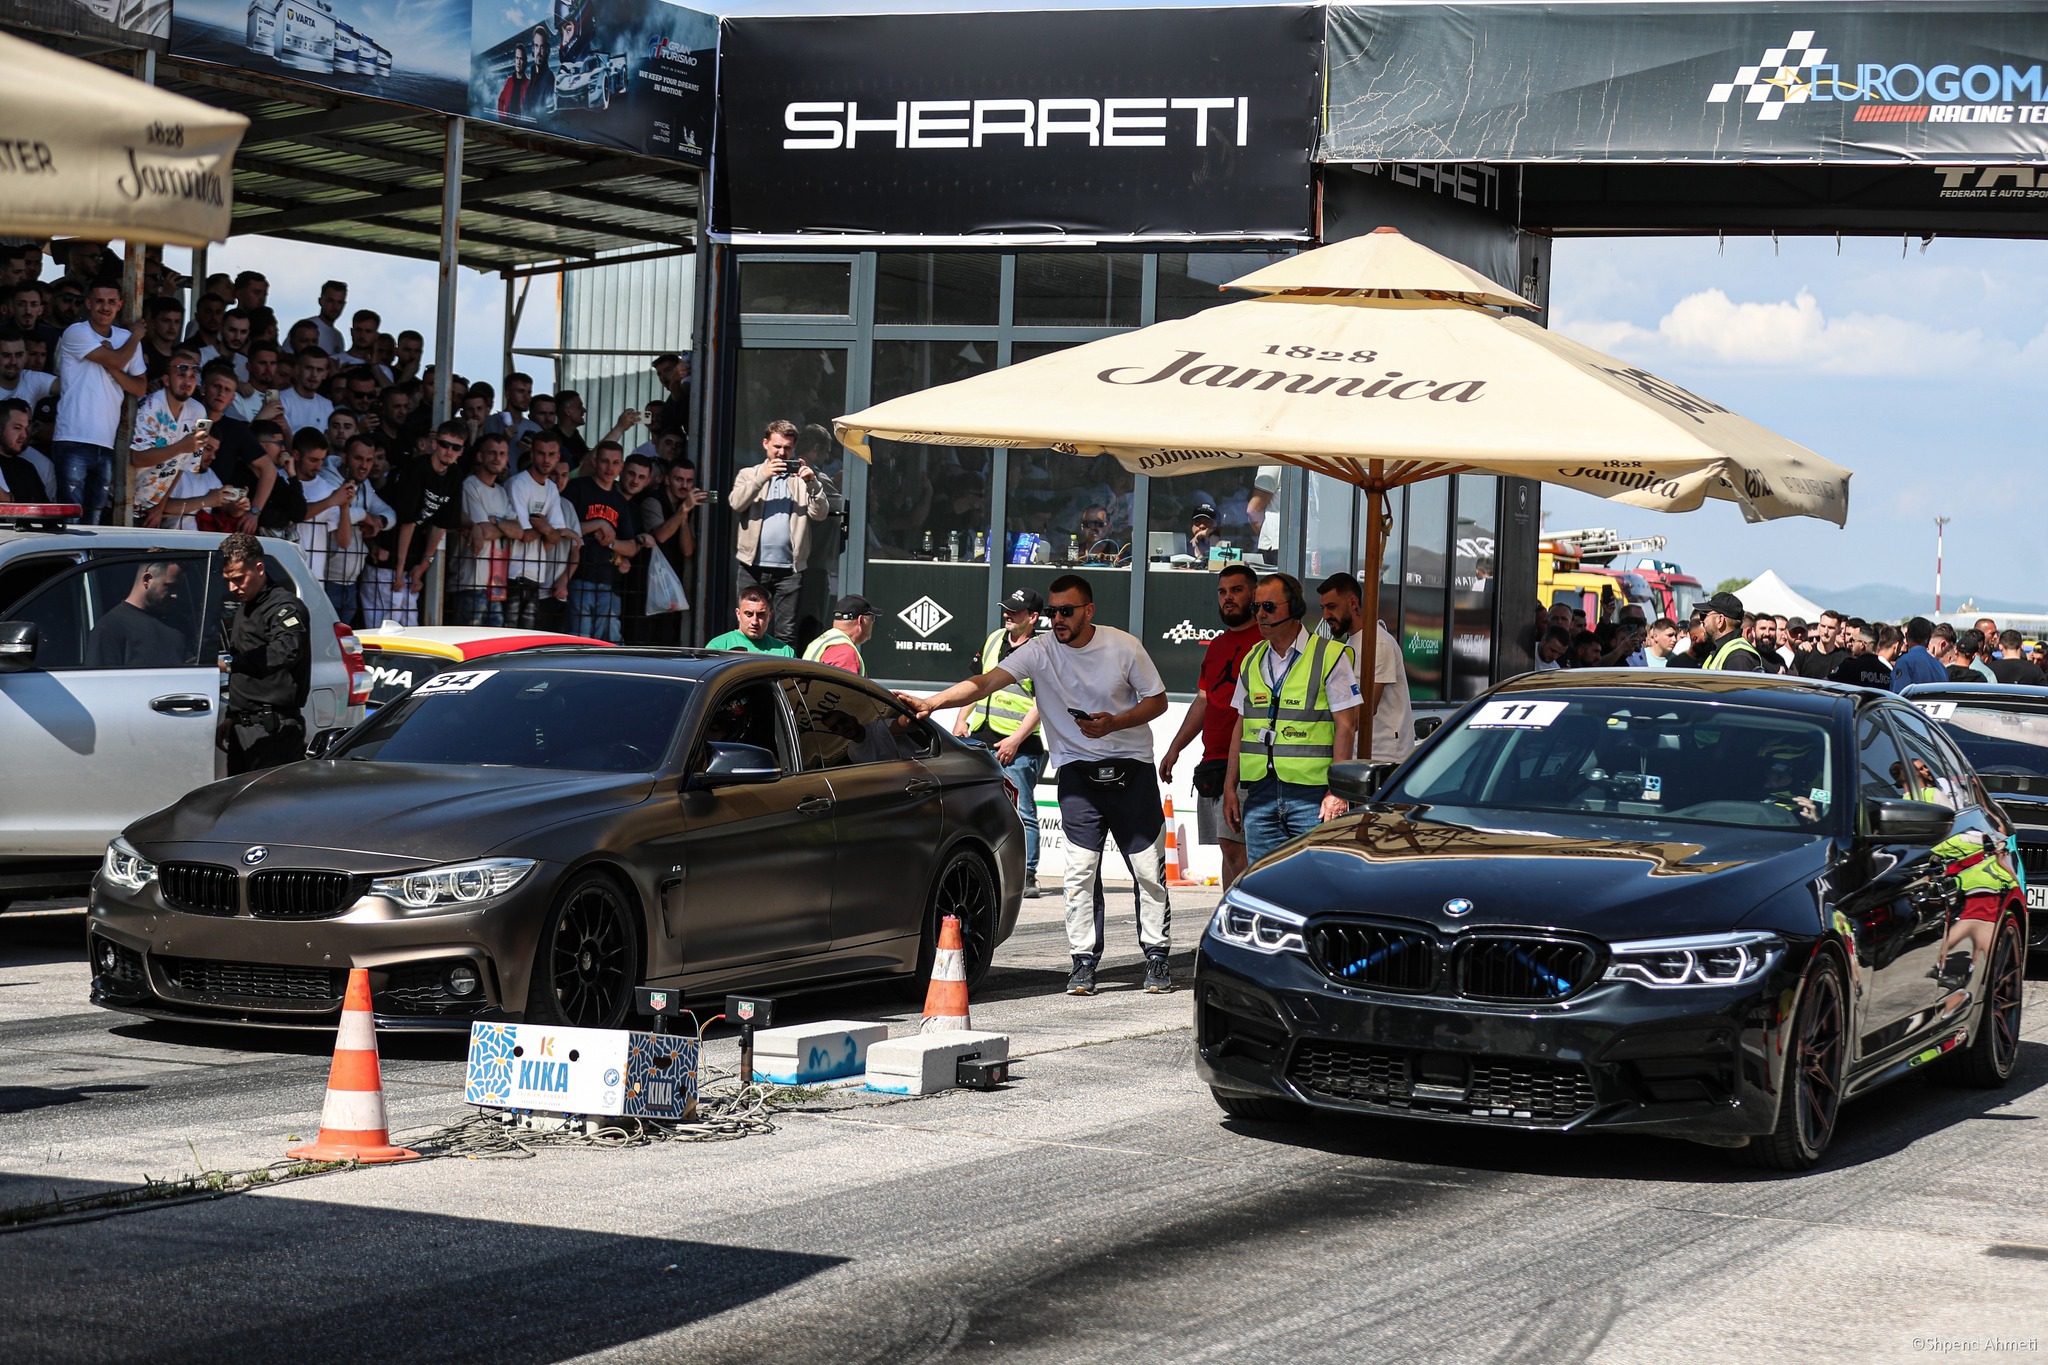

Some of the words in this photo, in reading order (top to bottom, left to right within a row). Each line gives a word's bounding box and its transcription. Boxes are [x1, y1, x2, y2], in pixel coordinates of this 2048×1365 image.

[295, 11, 316, 29] VARTA
[668, 41, 691, 55] GRAN
[661, 49, 698, 67] TURISMO
[638, 69, 648, 79] WE
[648, 72, 663, 82] KEEP
[662, 76, 678, 87] YOUR
[677, 79, 700, 92] DREAMS
[653, 83, 661, 92] IN
[1811, 63, 2048, 102] EUROGOM
[783, 97, 1249, 149] SHERRETI
[1928, 105, 2014, 123] RACING
[2018, 105, 2048, 123] TE
[146, 120, 185, 149] 1828
[0, 139, 58, 175] TER
[678, 145, 703, 156] MICHELIN
[117, 146, 224, 207] Jamnica
[1940, 190, 1987, 198] FEDERATA
[1990, 190, 1997, 198] E
[1998, 190, 2025, 198] AUTO
[1264, 344, 1378, 363] 1828
[1097, 350, 1485, 402] Jamnica
[1603, 460, 1643, 468] 1828
[895, 640, 913, 650] HIB
[914, 641, 953, 652] PETROL
[366, 665, 413, 689] MA
[426, 672, 481, 689] 34
[1501, 704, 1538, 720] 11
[518, 1059, 569, 1093] KIKA
[648, 1081, 673, 1106] KIKA
